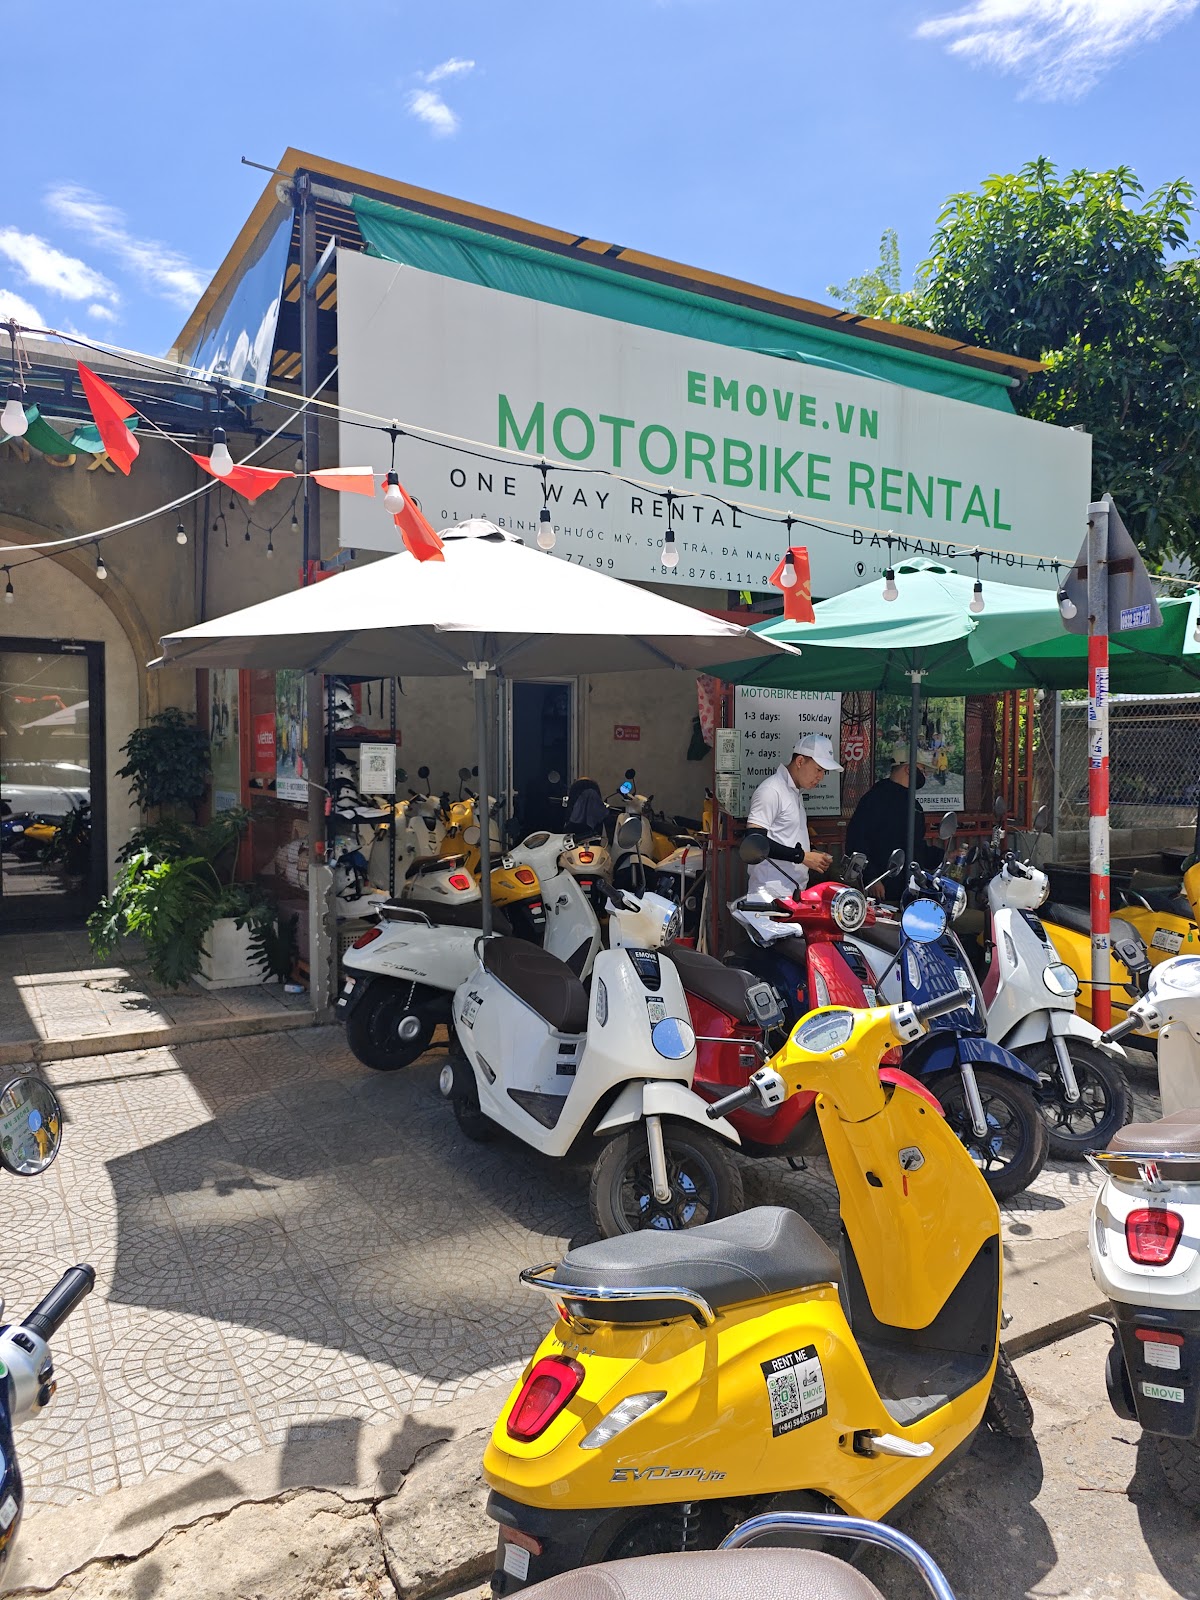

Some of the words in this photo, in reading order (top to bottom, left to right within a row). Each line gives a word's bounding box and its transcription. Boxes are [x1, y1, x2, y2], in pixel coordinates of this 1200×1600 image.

[687, 370, 879, 440] EMOVE.VN
[498, 393, 831, 502] MOTORBIKE
[849, 461, 1012, 531] RENTAL
[450, 468, 517, 496] ONE
[540, 482, 610, 510] WAY
[631, 496, 742, 529] RENTAL
[441, 510, 459, 521] 01
[647, 538, 667, 548] SƠ
[741, 688, 798, 699] MOTORBIKE
[801, 690, 836, 701] RENTAL
[744, 712, 756, 720] 1-3
[760, 712, 780, 722] days:
[798, 713, 832, 724] 150k/day
[744, 731, 756, 739] 4-6
[760, 731, 781, 741] days:
[745, 749, 754, 757] 7+
[845, 742, 863, 761] 5G
[635, 951, 657, 960] EMOVE
[772, 1354, 794, 1371] RENT
[794, 1349, 808, 1363] ME
[803, 1385, 823, 1400] EMOVE
[1144, 1386, 1182, 1400] EMOVE
